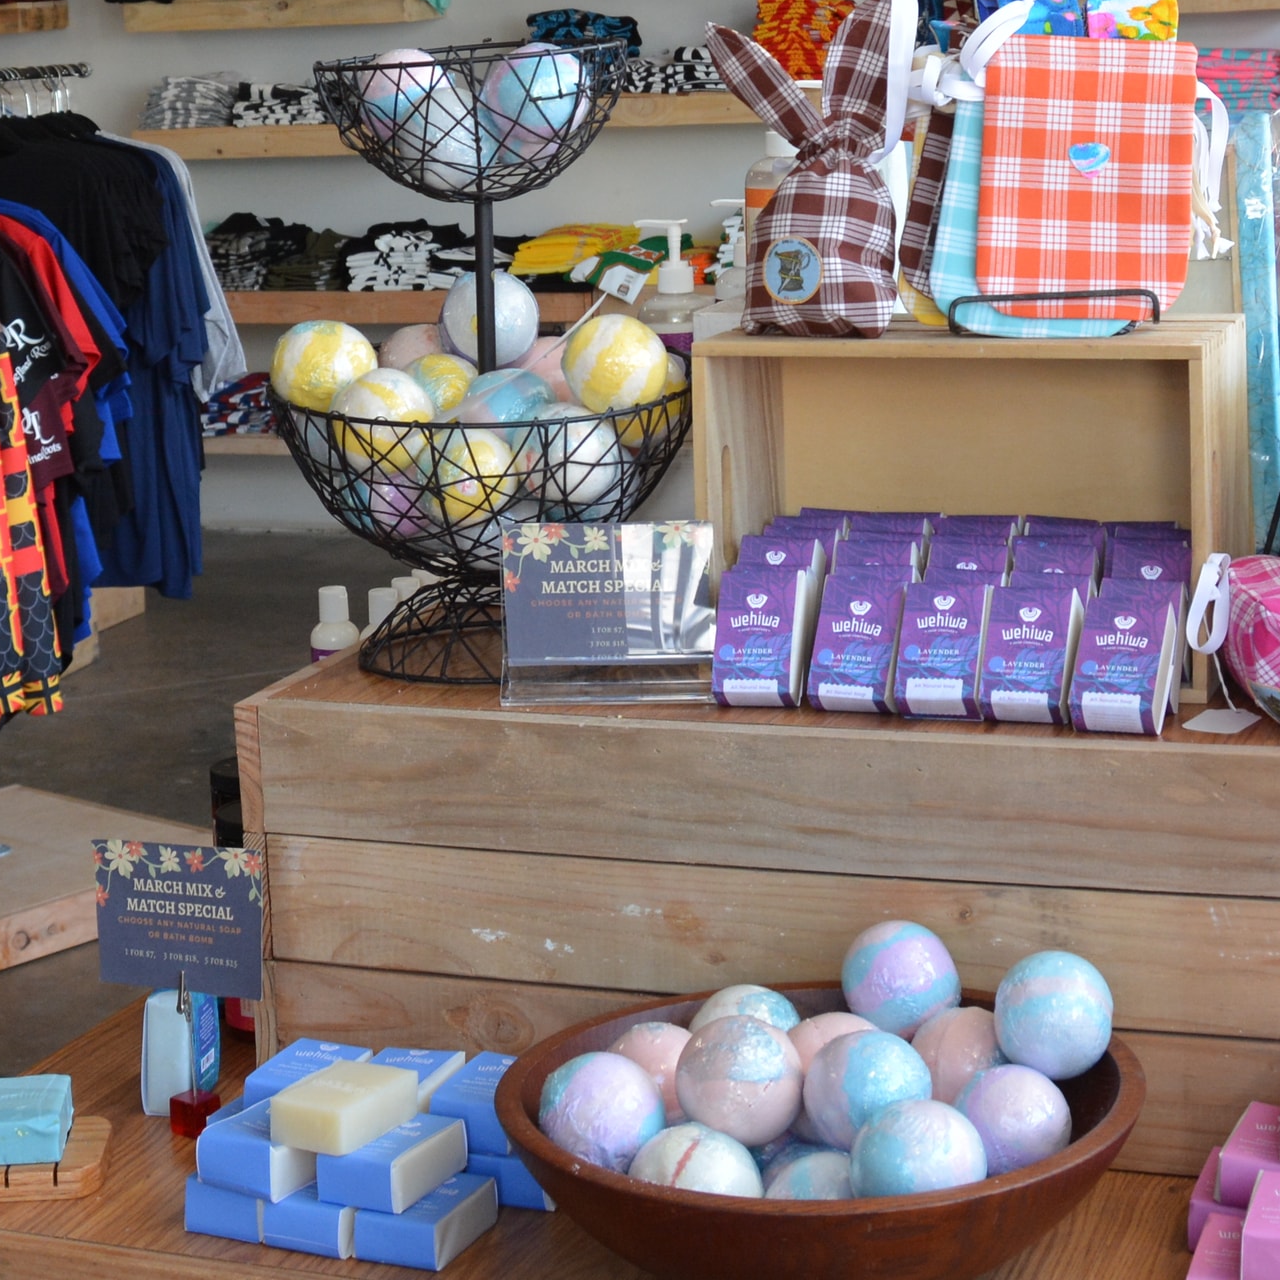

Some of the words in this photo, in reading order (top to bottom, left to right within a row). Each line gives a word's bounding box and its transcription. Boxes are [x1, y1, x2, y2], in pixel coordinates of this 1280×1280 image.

[550, 560, 611, 574] MARCH
[541, 580, 601, 594] MATCH
[530, 598, 573, 608] CHOOSE
[578, 598, 599, 607] ANY
[585, 611, 613, 619] BATH
[730, 611, 781, 628] wehiwa
[916, 612, 968, 630] wehiwa
[831, 617, 883, 637] wehiwa
[1001, 624, 1054, 643] wehiwa
[1095, 631, 1149, 649] wehiwa
[732, 647, 773, 655] LAVENDER
[830, 652, 872, 663] LAVENDER
[917, 648, 960, 656] LAVENDER
[1002, 660, 1045, 669] LAVENDER
[1094, 663, 1138, 673] LAVENDER
[133, 877, 182, 896] MARCH
[185, 882, 213, 898] MIX
[214, 885, 226, 899] &
[126, 897, 175, 915] MATCH
[178, 902, 234, 921] SPECIAL
[117, 916, 154, 926] CHOOSE
[156, 918, 174, 928] ANY
[177, 920, 216, 933] NATURAL
[219, 925, 242, 935] SOAP
[148, 930, 160, 939] OR
[163, 932, 186, 941] BATH
[188, 935, 214, 945] BOMB
[130, 948, 144, 958] FOR
[169, 953, 183, 962] FOR
[210, 957, 224, 967] FOR
[225, 959, 238, 969] $25
[385, 1054, 435, 1065] wehiwa
